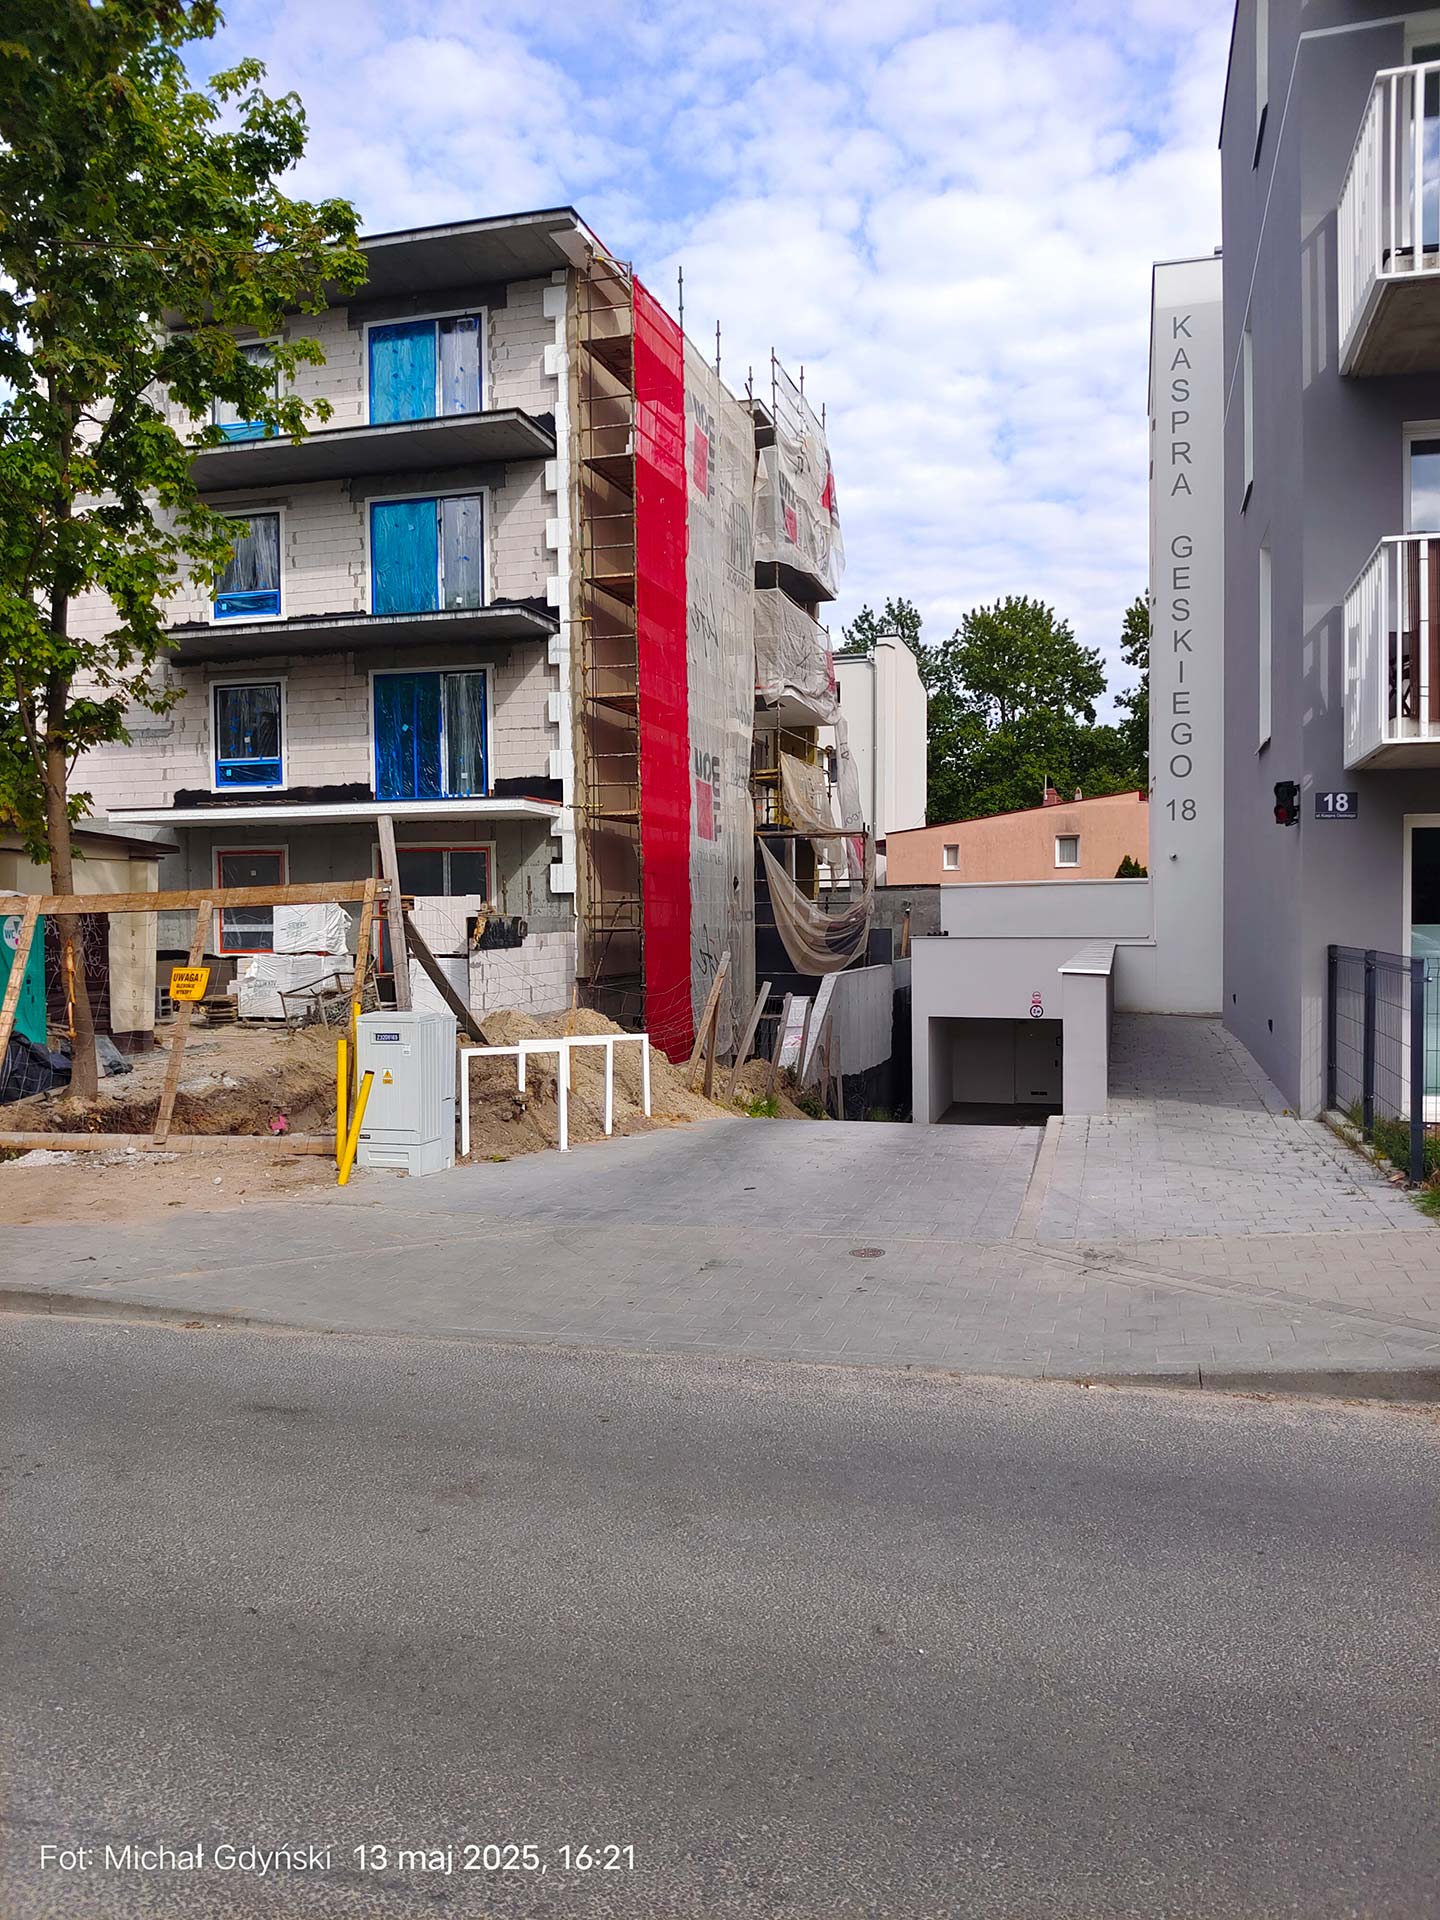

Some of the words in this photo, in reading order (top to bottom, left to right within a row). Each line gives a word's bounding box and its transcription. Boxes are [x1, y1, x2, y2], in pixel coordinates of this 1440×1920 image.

[1170, 314, 1193, 497] KASPRA
[1169, 535, 1194, 778] GESKIEGO
[1166, 799, 1197, 821] 18
[1323, 793, 1349, 812] 18
